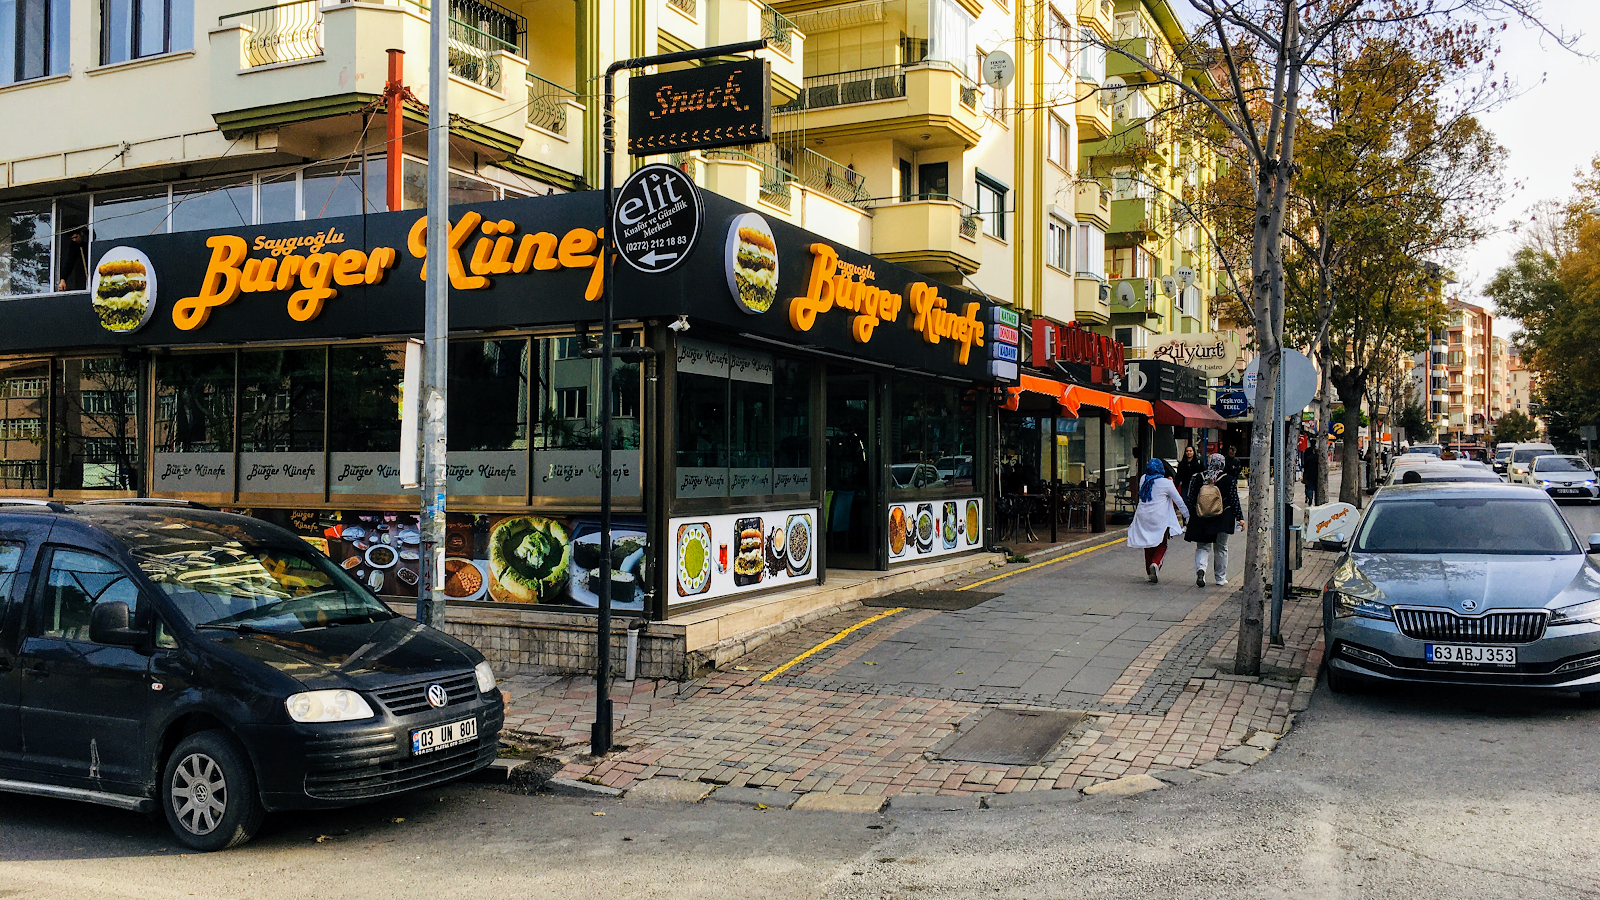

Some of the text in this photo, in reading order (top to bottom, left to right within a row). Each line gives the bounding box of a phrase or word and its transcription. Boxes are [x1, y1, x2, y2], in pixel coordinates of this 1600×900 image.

[649, 69, 750, 120] Snack
[618, 173, 682, 226] elit
[623, 199, 688, 238] Kuaför ve Güzellik
[642, 217, 673, 239] Merkezi
[252, 226, 345, 256] Saygıoğlu
[625, 235, 688, 254] (0272) 212 18 83
[171, 234, 397, 332] Burger
[788, 242, 985, 366] Burger Künefe
[1001, 309, 1017, 325] KATMER
[161, 463, 226, 481] Burger Künefe
[246, 463, 316, 481] Burger Künefe
[337, 464, 374, 482] Burger
[478, 464, 517, 482] Künefe
[1434, 646, 1515, 662] 63 ABJ 353
[421, 730, 434, 747] 03
[441, 725, 453, 742] UN
[460, 719, 476, 738] 801
